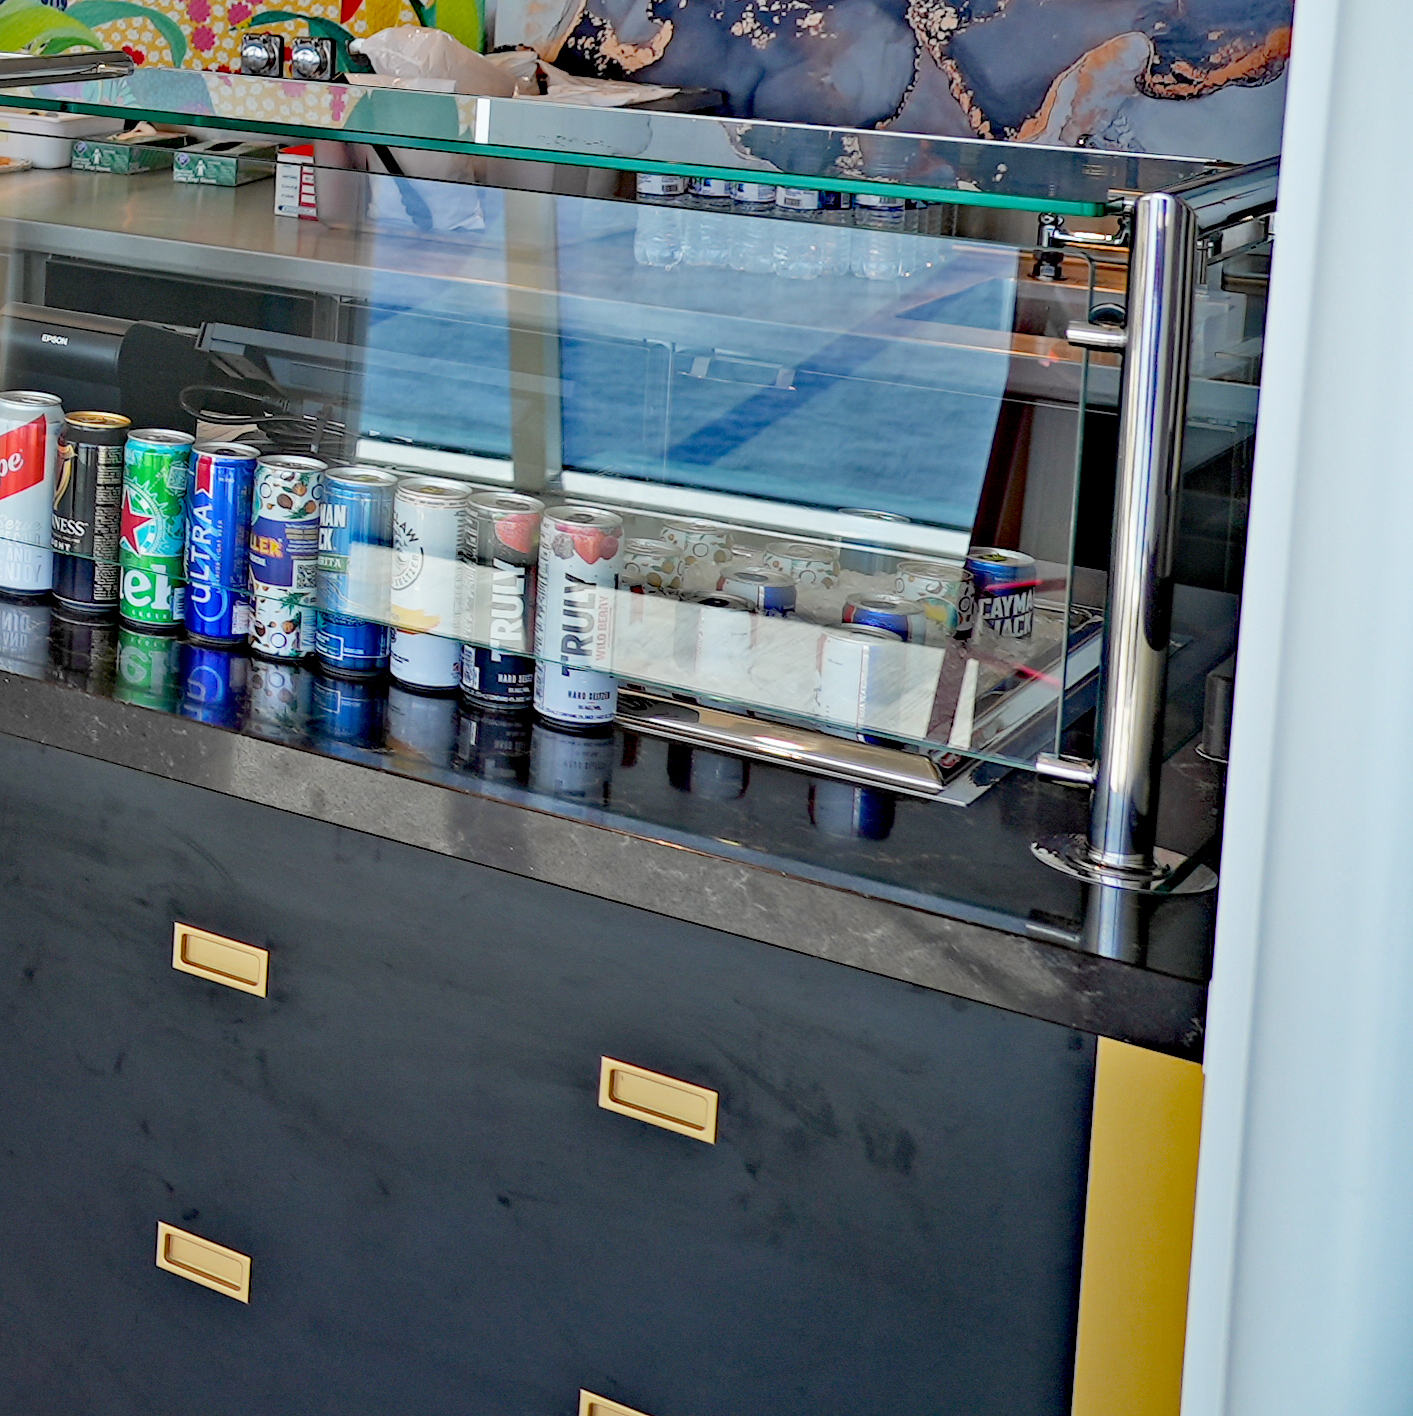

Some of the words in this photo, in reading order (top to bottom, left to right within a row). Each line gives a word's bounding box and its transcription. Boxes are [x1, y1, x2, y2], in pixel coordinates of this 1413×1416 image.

[42, 334, 68, 345] EPSON
[7, 546, 32, 562] AND
[190, 503, 213, 604] ULTRA
[490, 558, 525, 662] TRULY
[597, 596, 609, 632] BERRY
[978, 588, 1033, 620] CAYMA
[560, 572, 597, 677] TRULY
[596, 636, 606, 662] WILD
[568, 690, 586, 700] HARD
